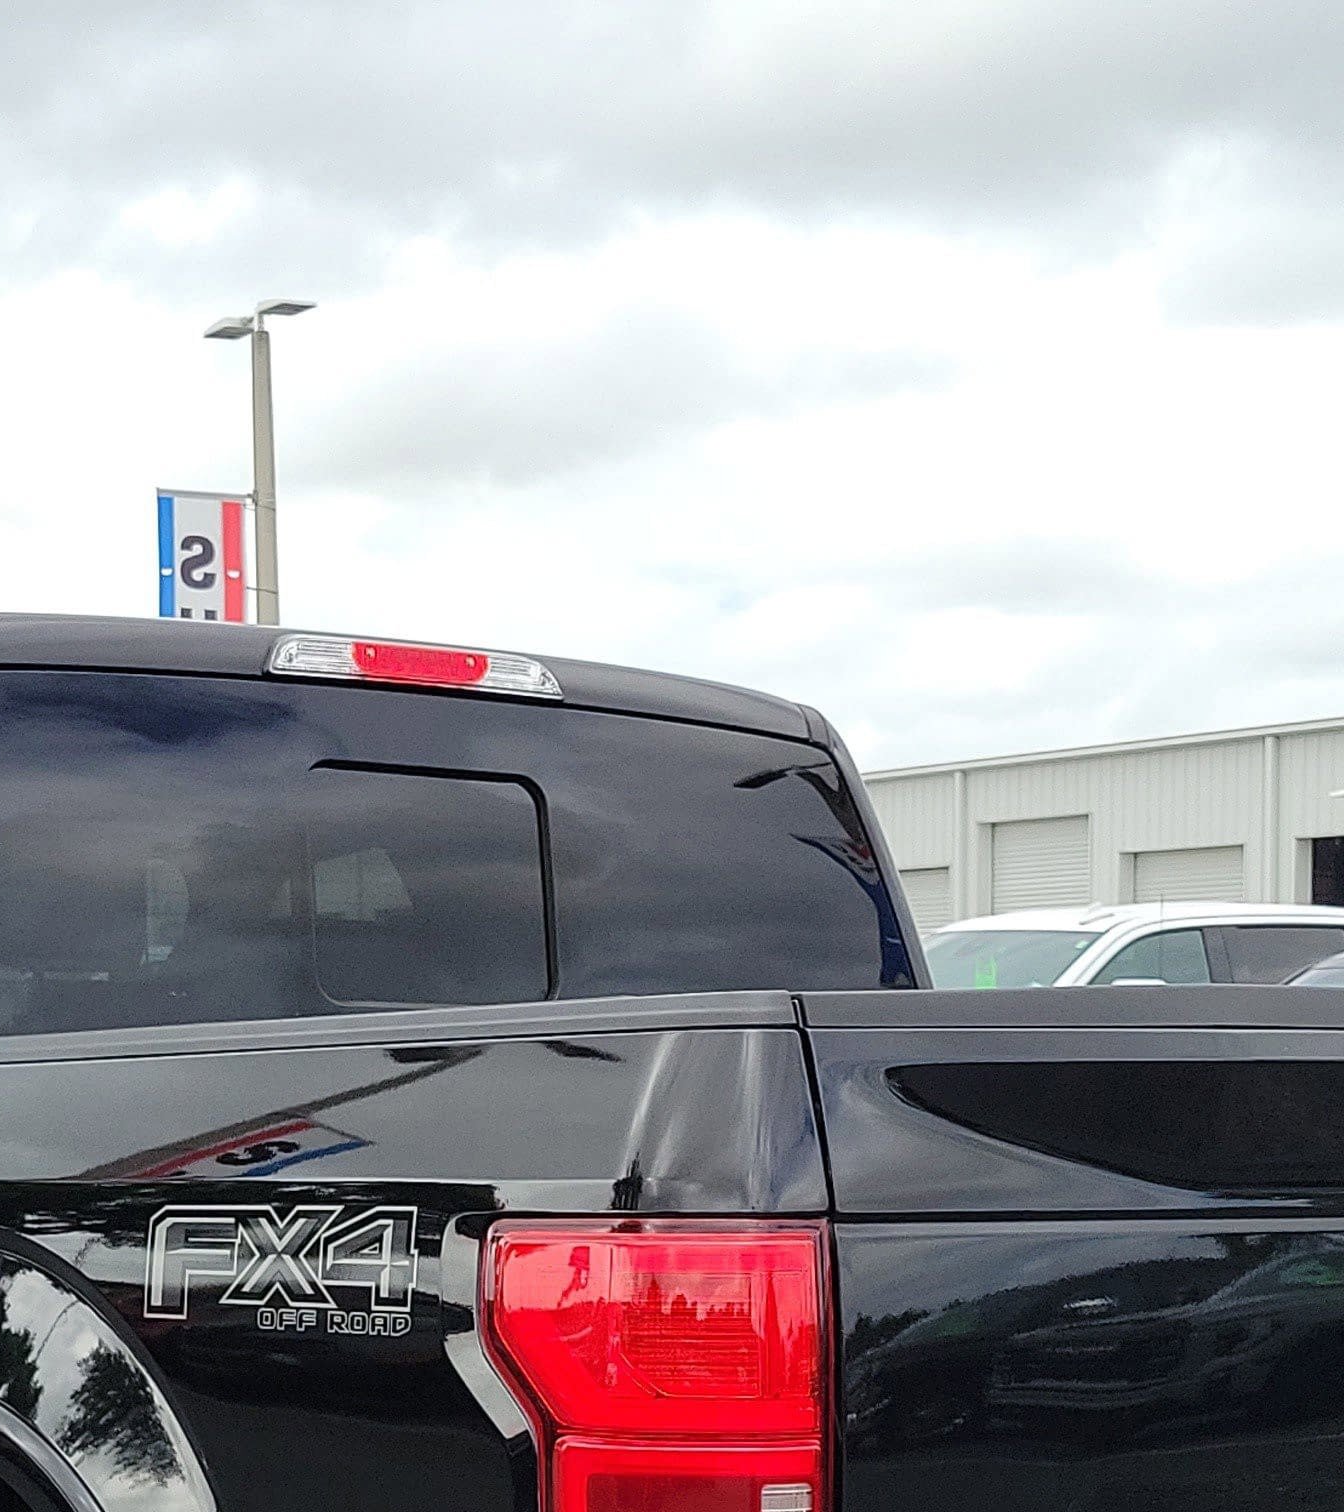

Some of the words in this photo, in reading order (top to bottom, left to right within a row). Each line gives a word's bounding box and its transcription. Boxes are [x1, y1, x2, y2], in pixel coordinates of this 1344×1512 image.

[144, 1205, 418, 1319] FX4
[257, 1307, 317, 1332] OFF
[327, 1310, 411, 1337] ROAD
